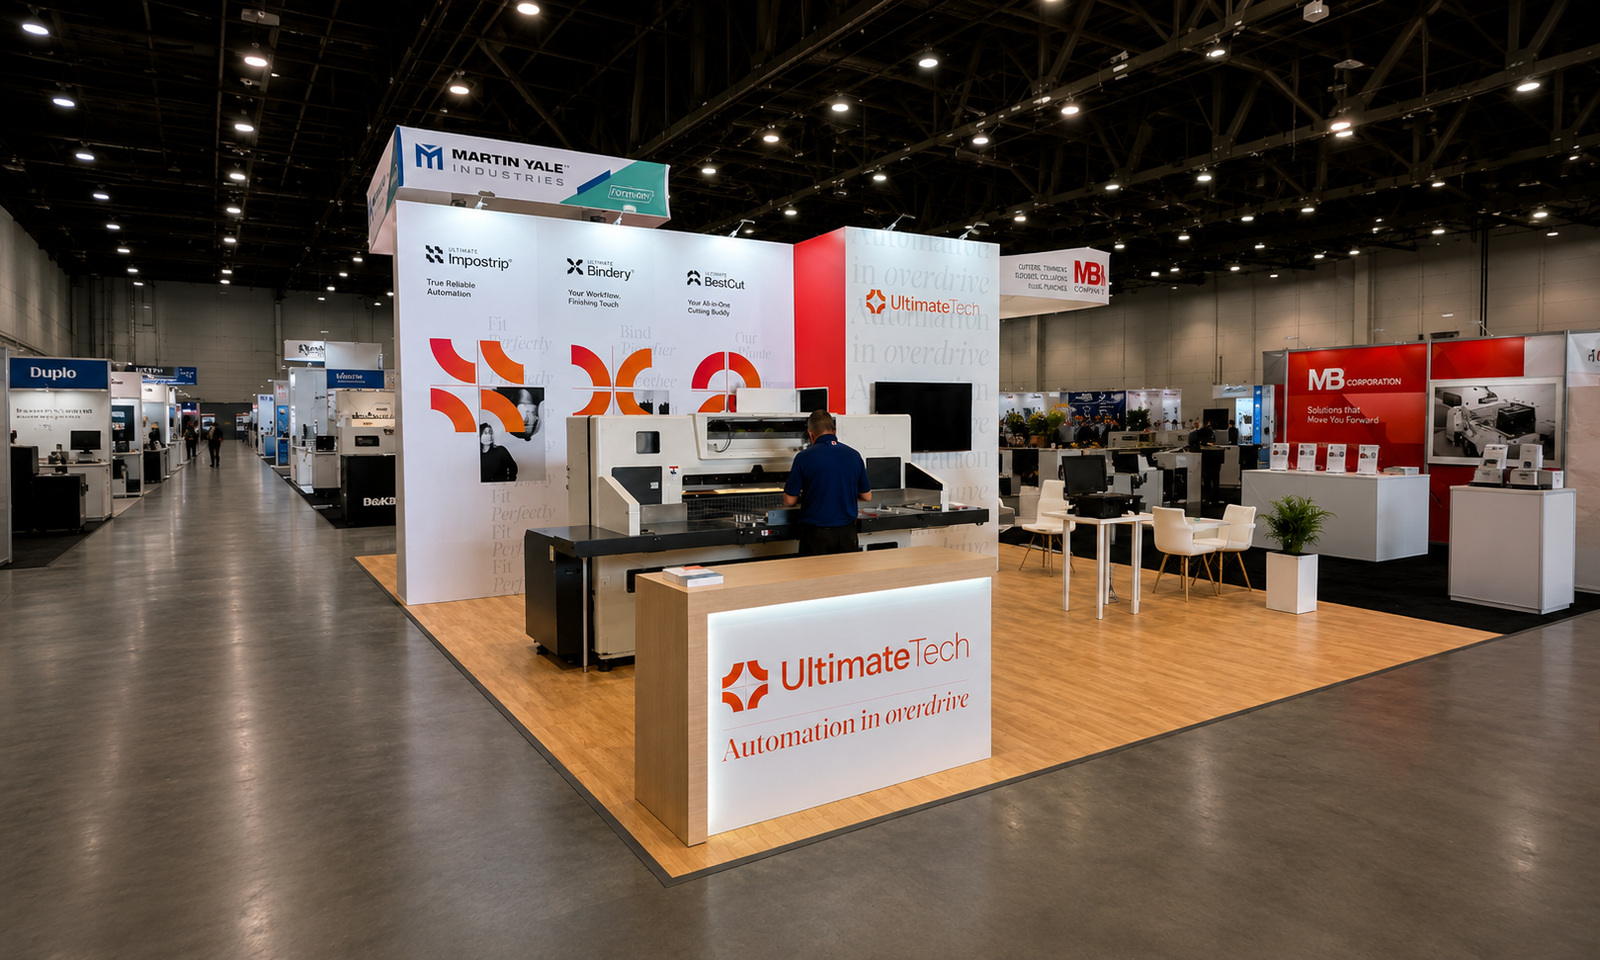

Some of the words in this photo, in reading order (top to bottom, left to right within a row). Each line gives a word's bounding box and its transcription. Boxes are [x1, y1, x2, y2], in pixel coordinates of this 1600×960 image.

[452, 149, 520, 167] MARTIN
[453, 164, 564, 186] INDUSTRIES
[852, 256, 876, 285] in
[884, 265, 990, 294] overdrive
[427, 278, 444, 286] True
[446, 280, 476, 289] Reliable
[704, 276, 745, 290] BestCut
[427, 288, 471, 297] Automation
[568, 289, 584, 297] Your
[568, 298, 598, 308] Finishing
[599, 300, 619, 308] Touch
[890, 294, 980, 316] UltimateTech
[688, 307, 710, 316] Cutting
[711, 308, 730, 317] Buddy
[488, 316, 508, 331] Fit
[620, 325, 651, 339] Bind
[852, 334, 877, 363] in
[884, 339, 990, 366] overdrive
[30, 366, 77, 381] Duplo
[1308, 367, 1345, 391] MB
[1346, 378, 1402, 387] CORPORATION
[1307, 406, 1342, 414] Solutions
[1344, 406, 1360, 414] that
[1307, 415, 1328, 424] Move
[1330, 415, 1344, 424] You
[1346, 416, 1379, 424] Forward
[491, 489, 511, 504] Fit
[491, 504, 556, 524] Perfectly
[491, 524, 511, 539] Fit
[492, 559, 513, 575] Fit
[781, 632, 970, 692] UltimateTech
[722, 717, 855, 763] Automation
[860, 709, 880, 731] in
[885, 691, 970, 726] overdrive
